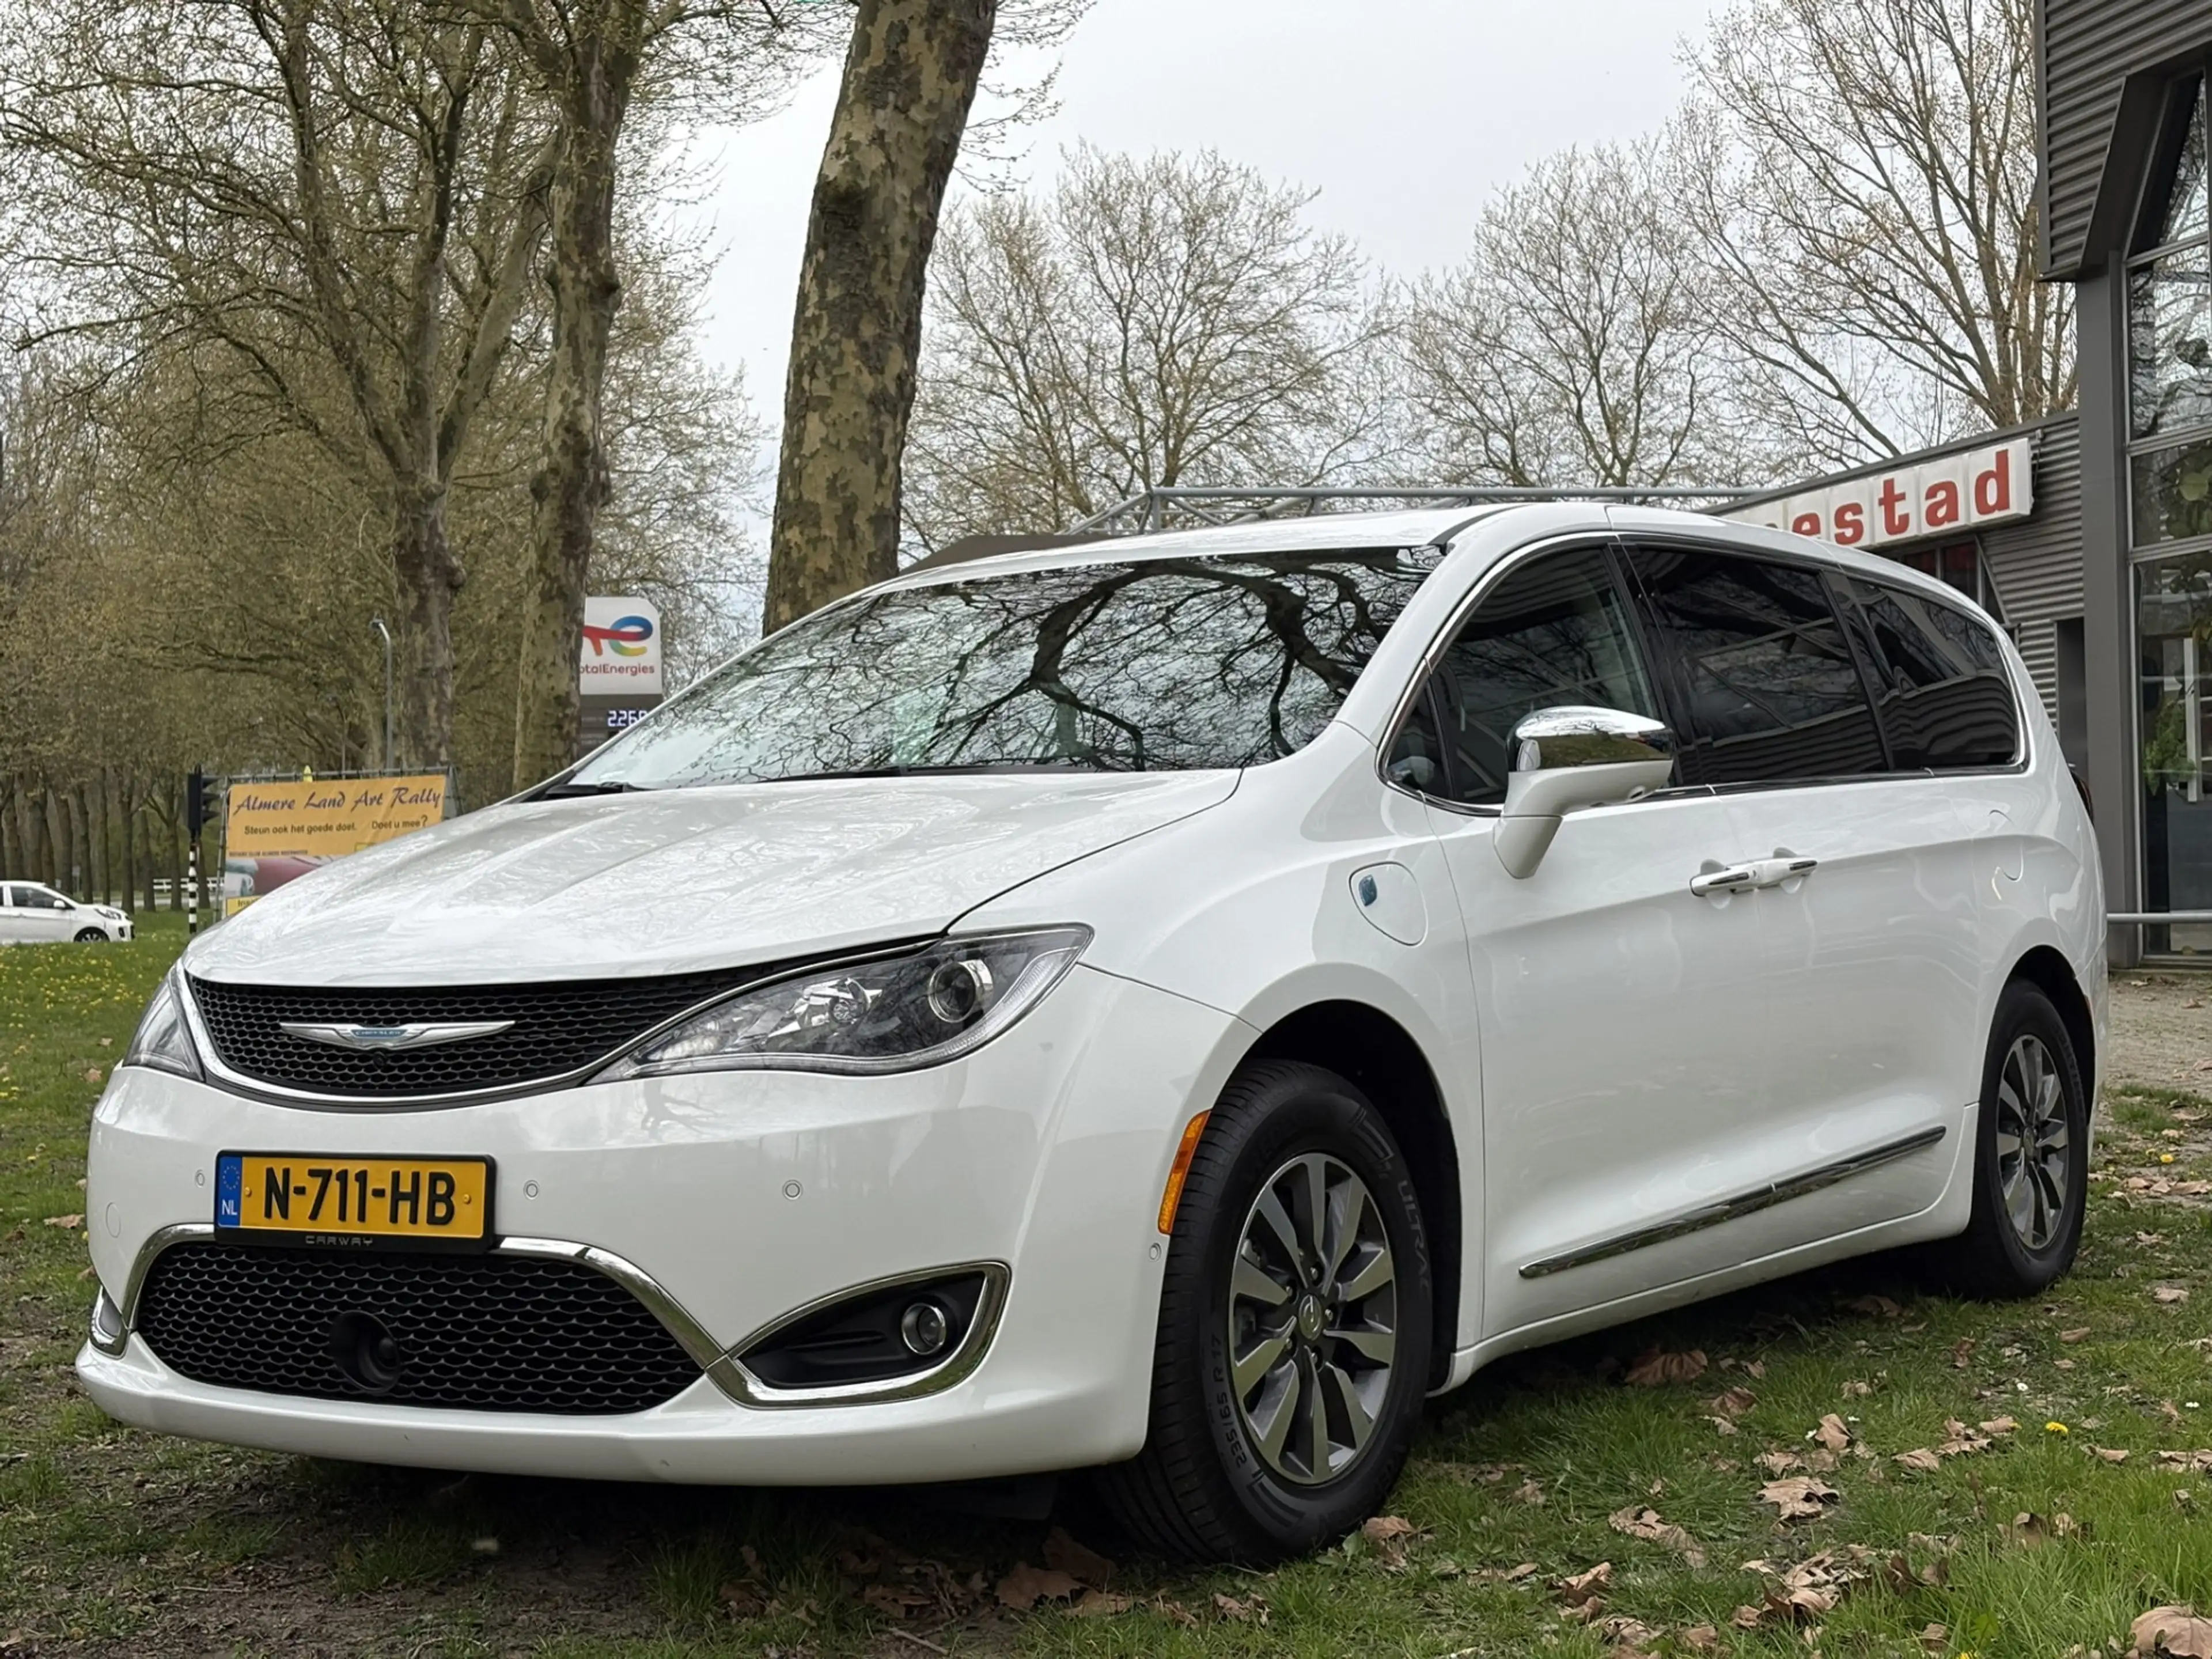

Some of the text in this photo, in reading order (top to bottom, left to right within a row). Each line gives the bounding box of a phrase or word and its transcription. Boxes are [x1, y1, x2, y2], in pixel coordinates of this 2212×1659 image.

[1764, 449, 2010, 545] estad
[579, 663, 655, 676] otalEnergies
[233, 787, 441, 816] Almere Land Art Rally
[244, 824, 270, 835] Steun
[272, 824, 288, 834] ook
[290, 823, 305, 833] het
[306, 822, 334, 835] goede
[371, 820, 392, 830] Doet
[394, 821, 400, 830] u
[264, 1166, 456, 1226] N-711-HB
[222, 1200, 237, 1216] NL
[305, 1235, 373, 1247] CARWAY
[1210, 1334, 1247, 1468] 235/65 R 17
